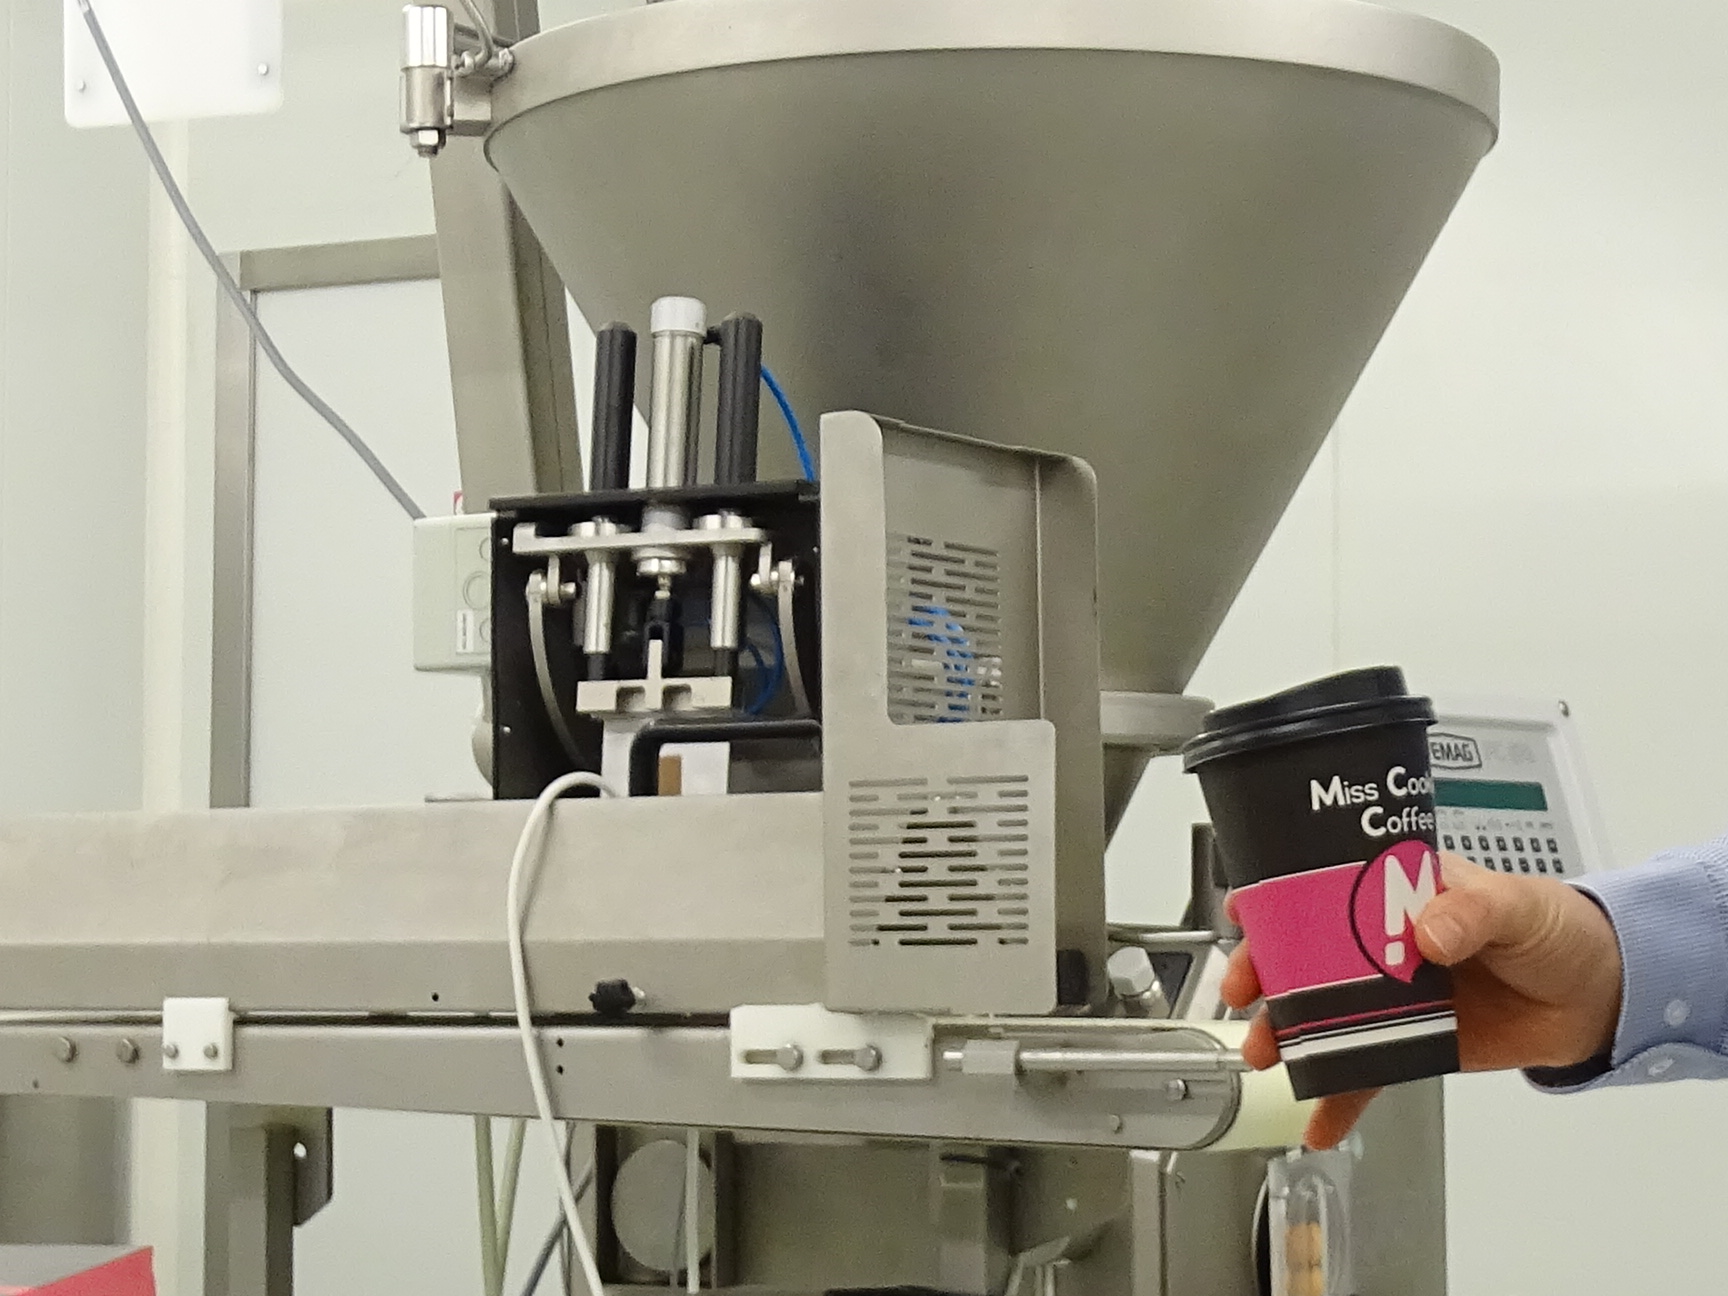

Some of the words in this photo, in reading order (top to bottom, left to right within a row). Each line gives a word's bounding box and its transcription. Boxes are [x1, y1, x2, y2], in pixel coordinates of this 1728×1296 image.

[1430, 741, 1473, 762] EMAG
[1310, 775, 1379, 811] Miss
[1360, 805, 1435, 837] Coffee
